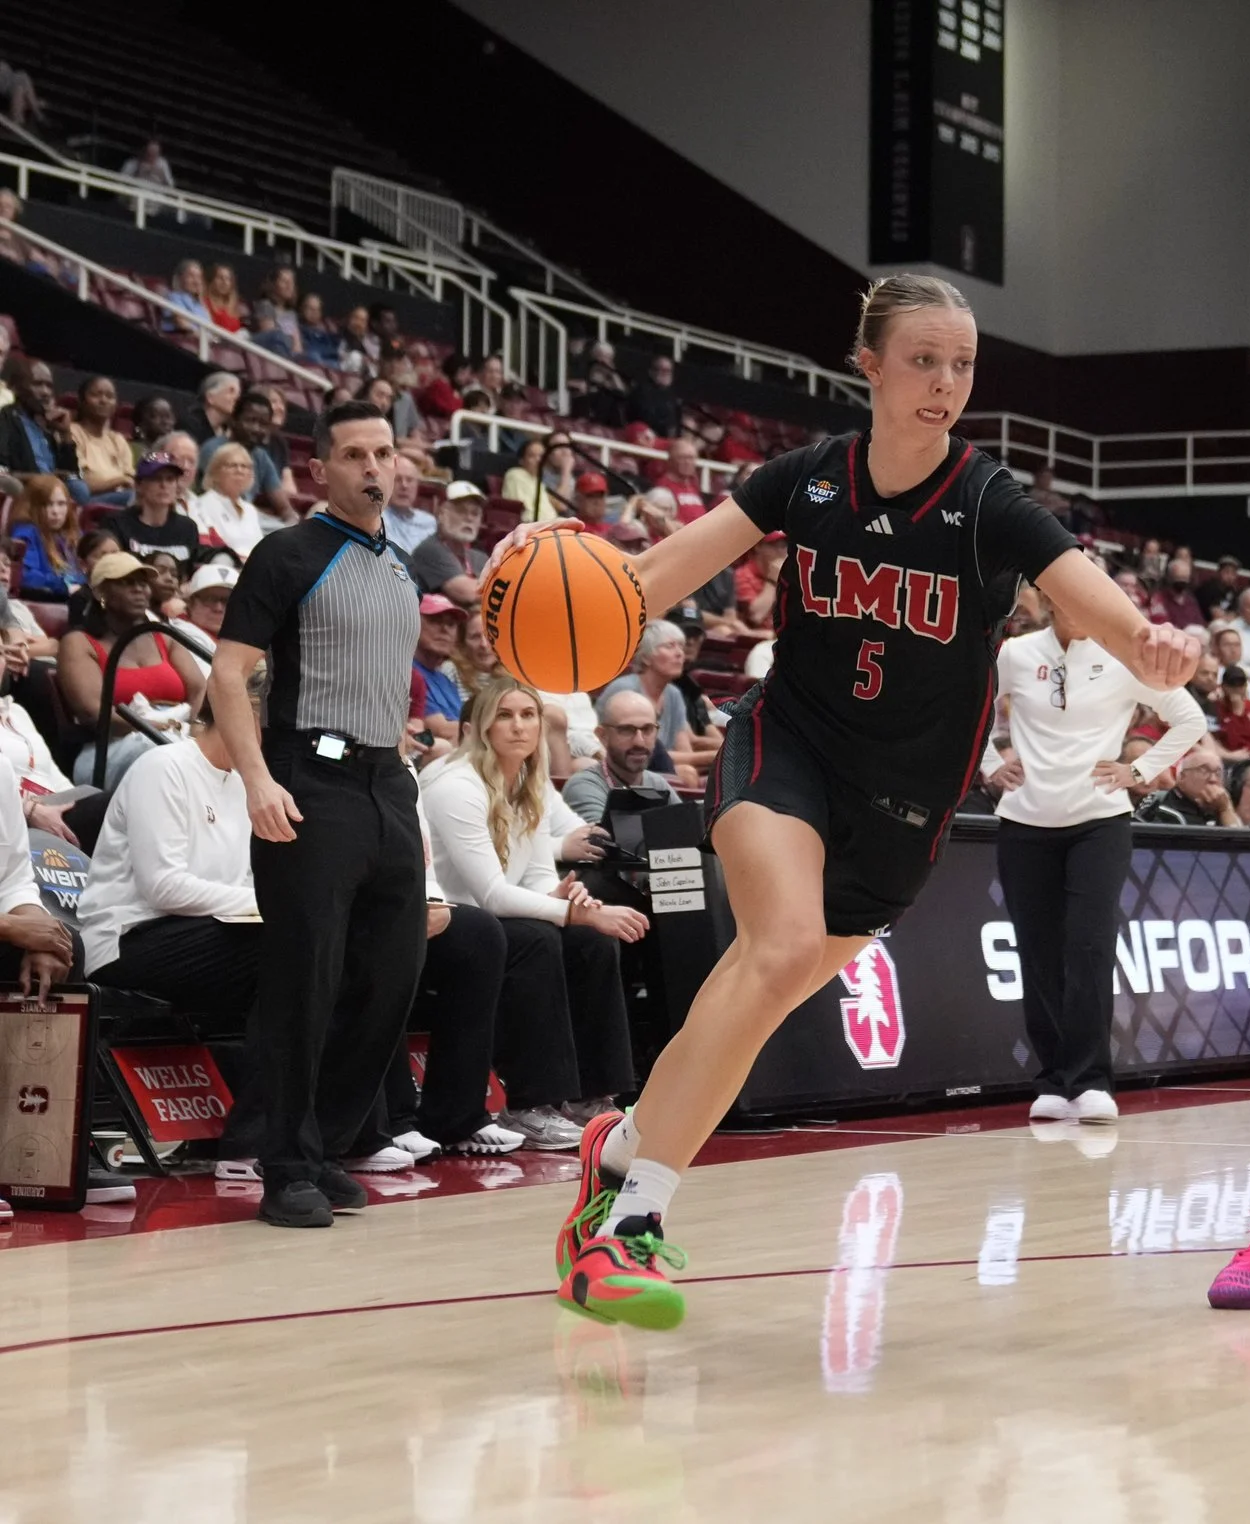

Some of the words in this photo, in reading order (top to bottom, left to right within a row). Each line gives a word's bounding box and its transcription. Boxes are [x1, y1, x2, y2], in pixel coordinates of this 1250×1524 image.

[807, 484, 837, 498] WBIT
[796, 544, 960, 645] LMU
[853, 639, 885, 700] 5
[36, 866, 89, 888] WBIT
[134, 1064, 211, 1090] WELLS
[151, 1095, 226, 1122] FARGO
